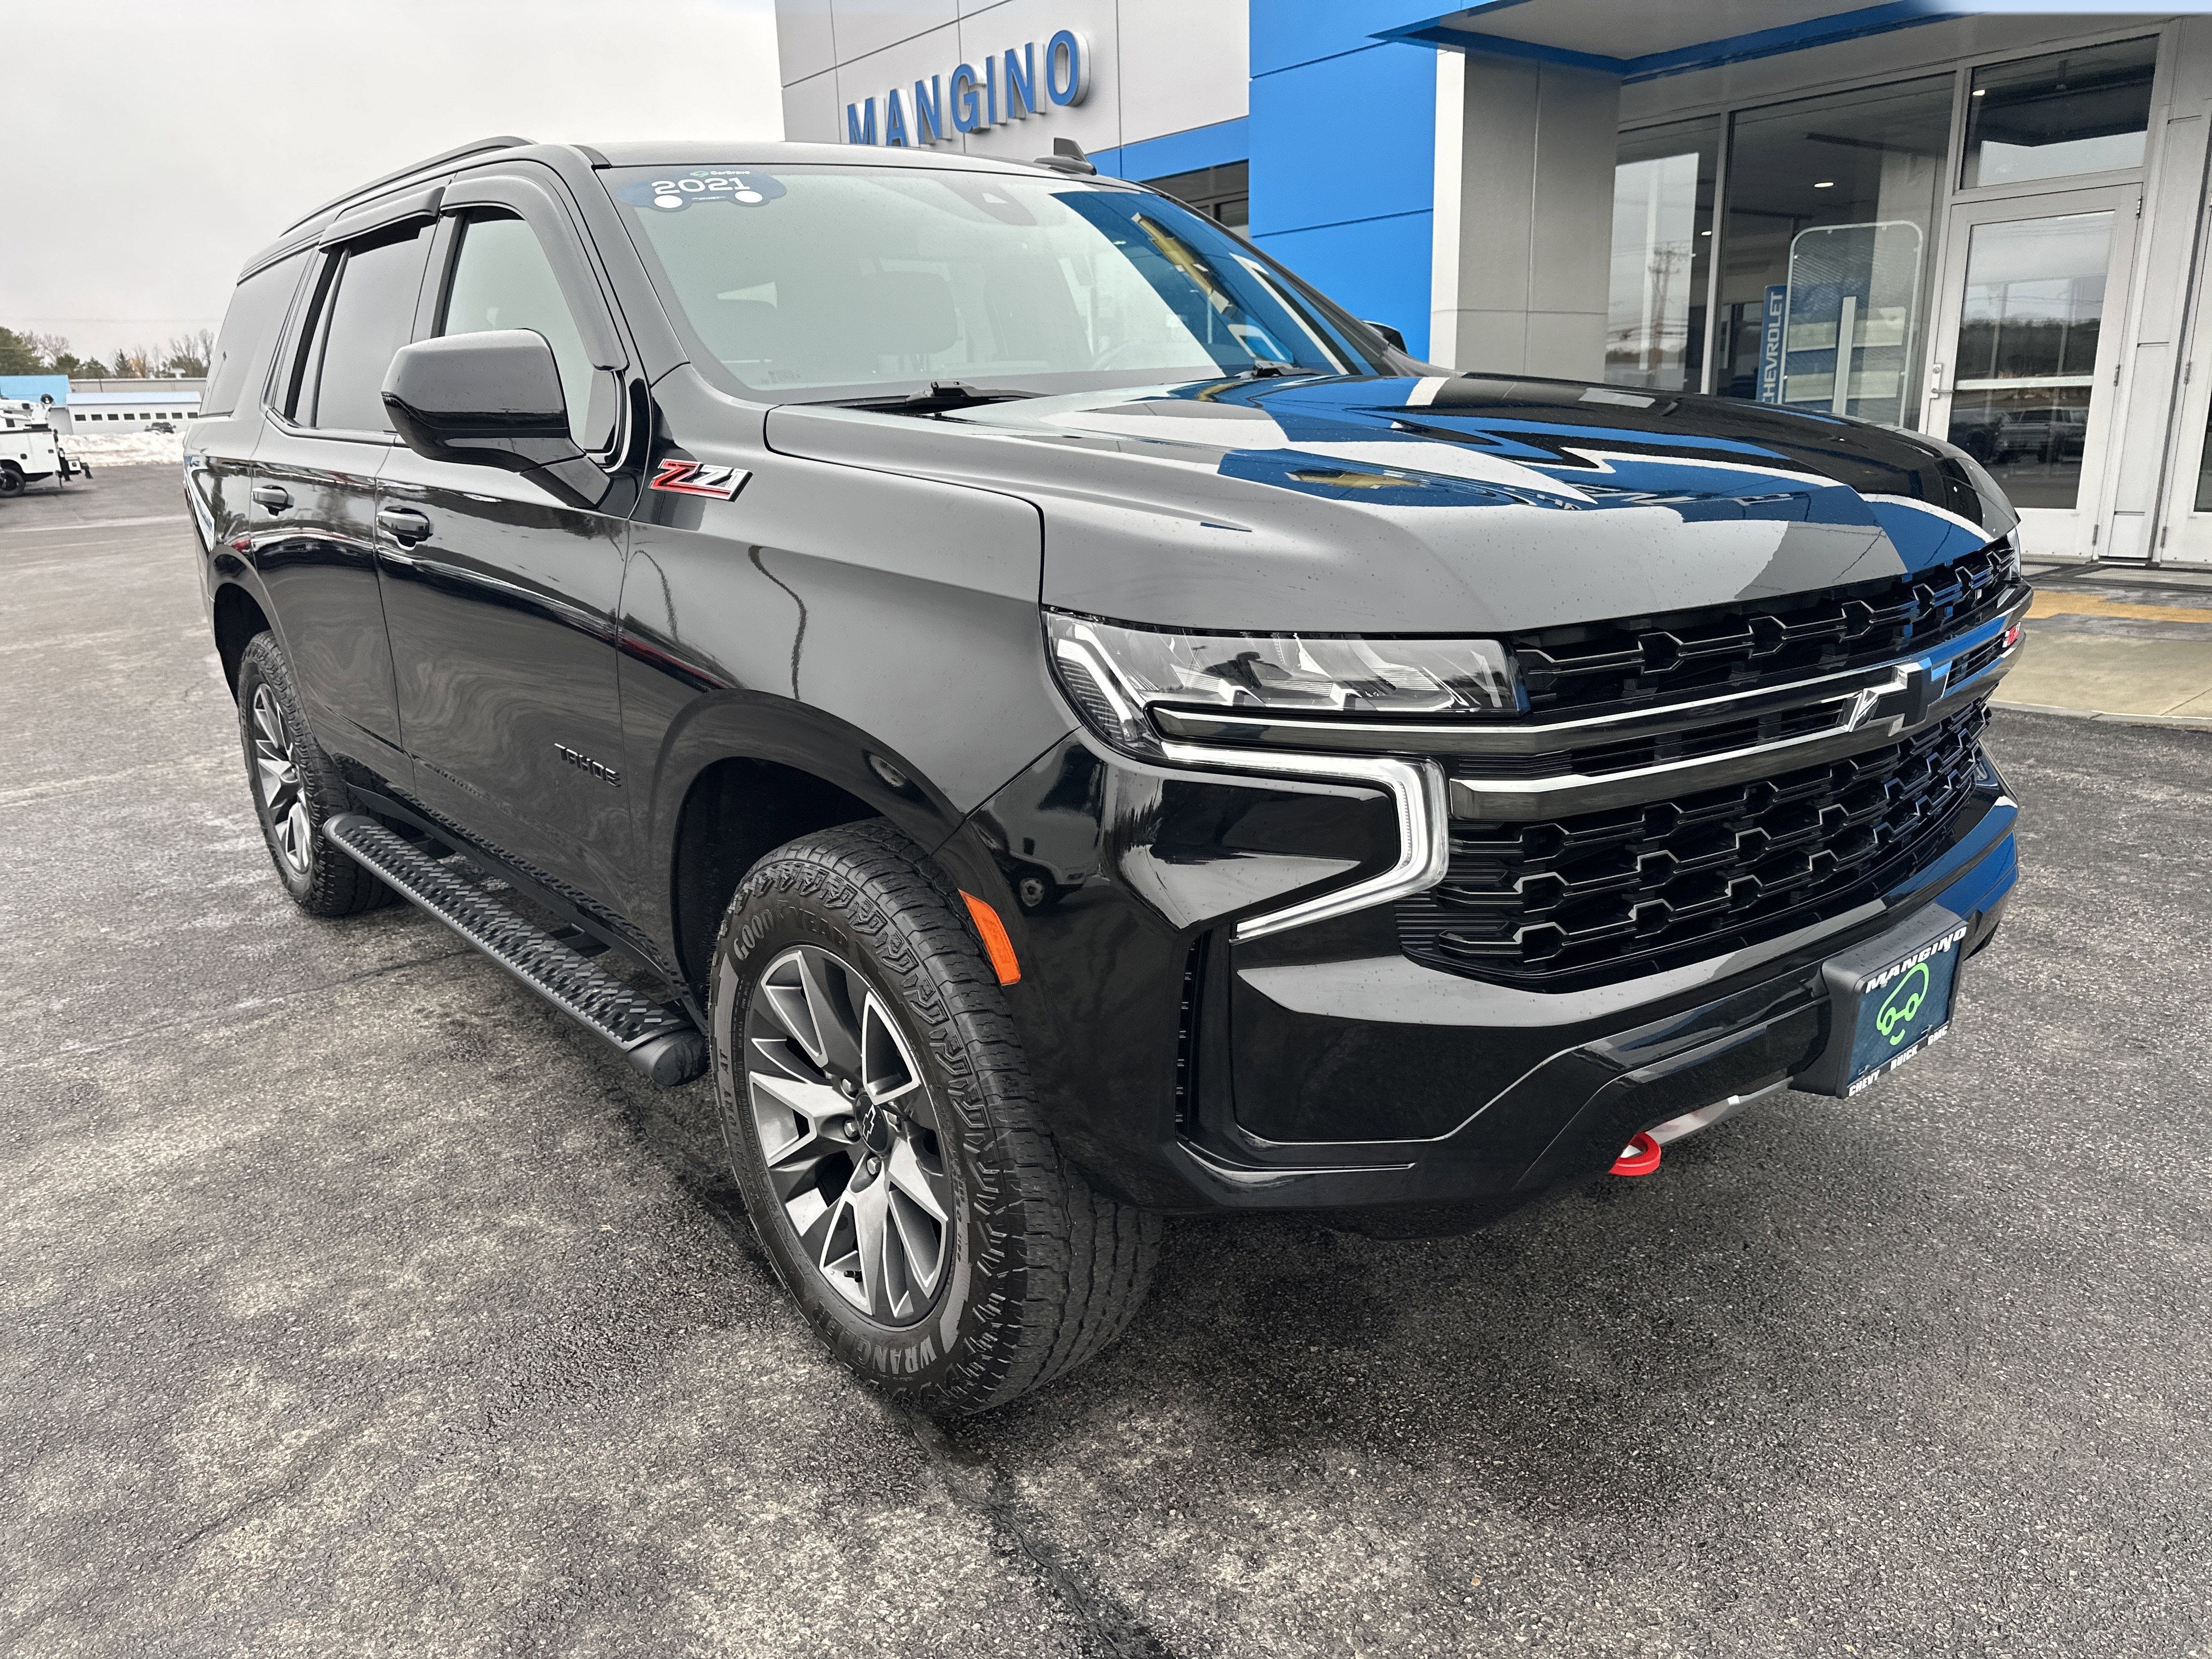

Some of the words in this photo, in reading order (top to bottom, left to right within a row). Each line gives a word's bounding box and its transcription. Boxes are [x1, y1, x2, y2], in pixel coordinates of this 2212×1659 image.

[847, 30, 1085, 147] MANGINO
[651, 177, 751, 195] 2021
[647, 459, 752, 501] Z71
[554, 743, 622, 788] TAHOE
[1865, 926, 1967, 994] MANGINO
[1848, 1069, 1881, 1097] CHEVY
[1890, 1045, 1918, 1071] BUICK
[1927, 1025, 1949, 1046] GMC
[812, 1301, 938, 1375] WRANGLER
